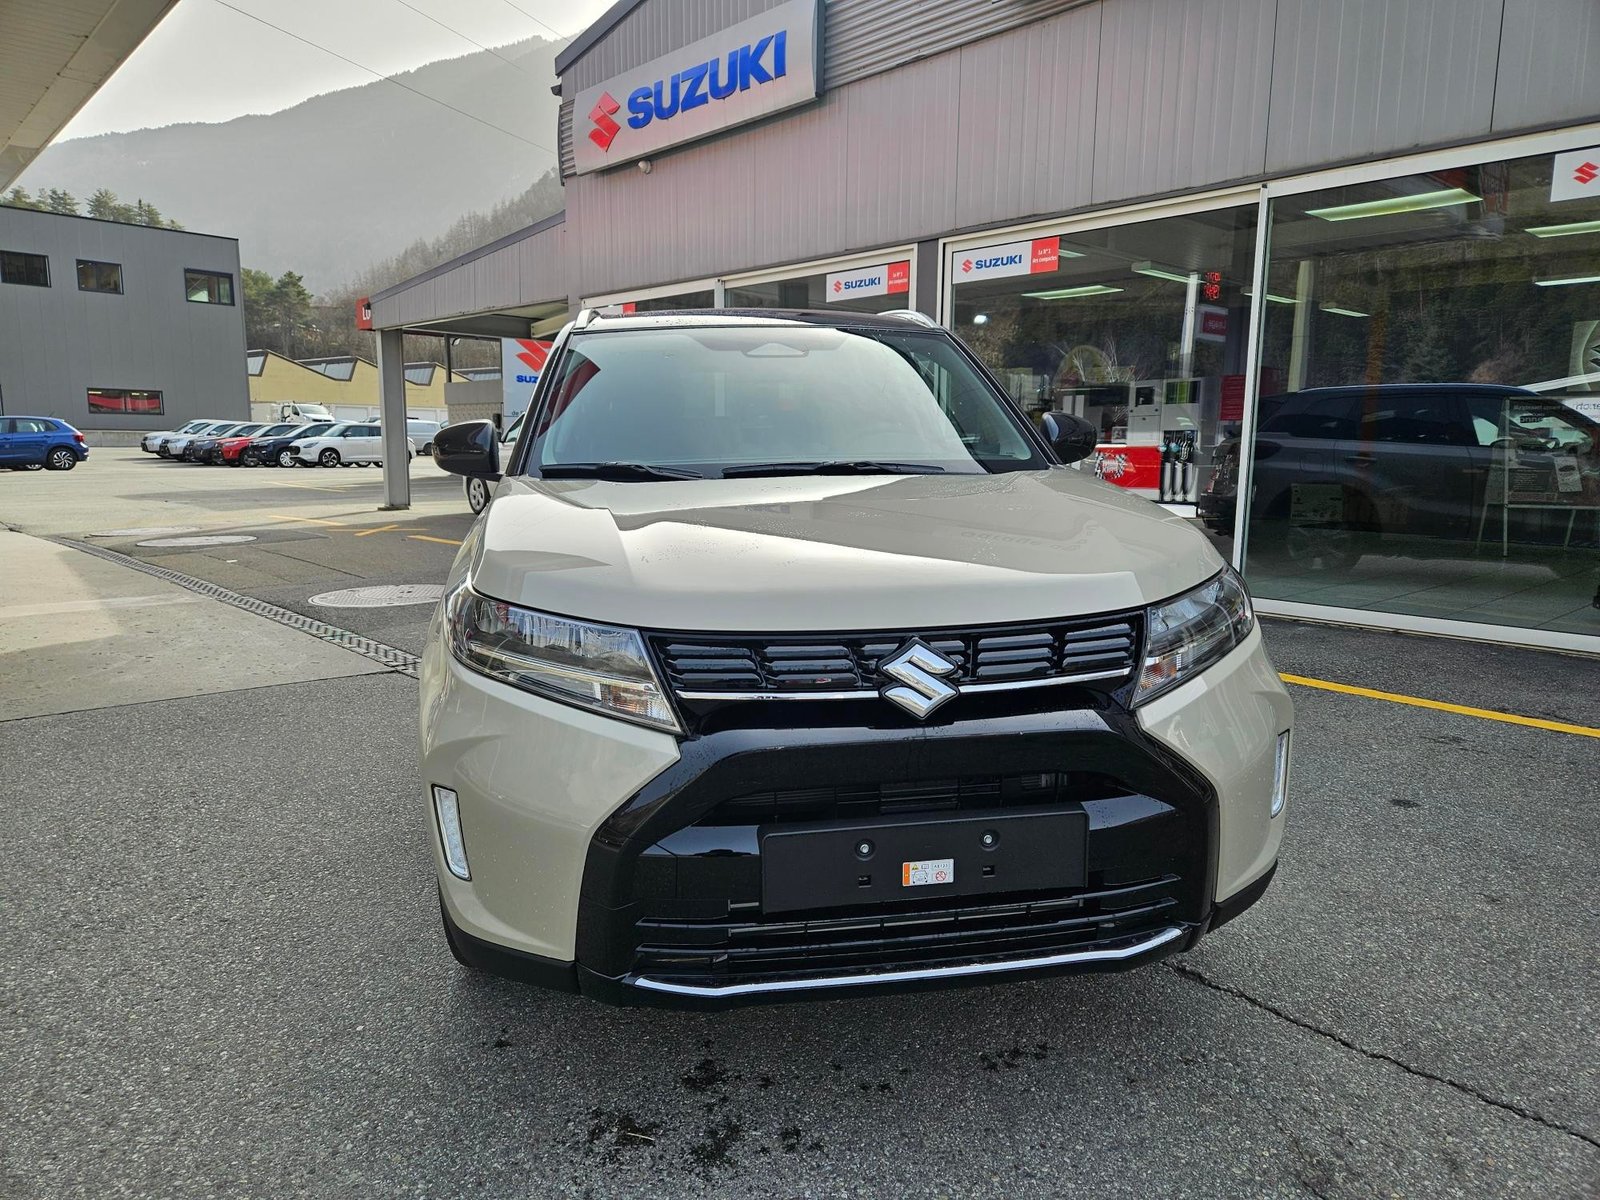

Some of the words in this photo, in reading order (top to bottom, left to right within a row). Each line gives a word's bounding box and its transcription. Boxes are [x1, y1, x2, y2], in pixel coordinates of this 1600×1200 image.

[627, 30, 787, 129] SUZUKI
[975, 254, 1022, 269] SUZUKI
[844, 276, 880, 290] SUZUKI
[516, 374, 538, 383] SUZ
